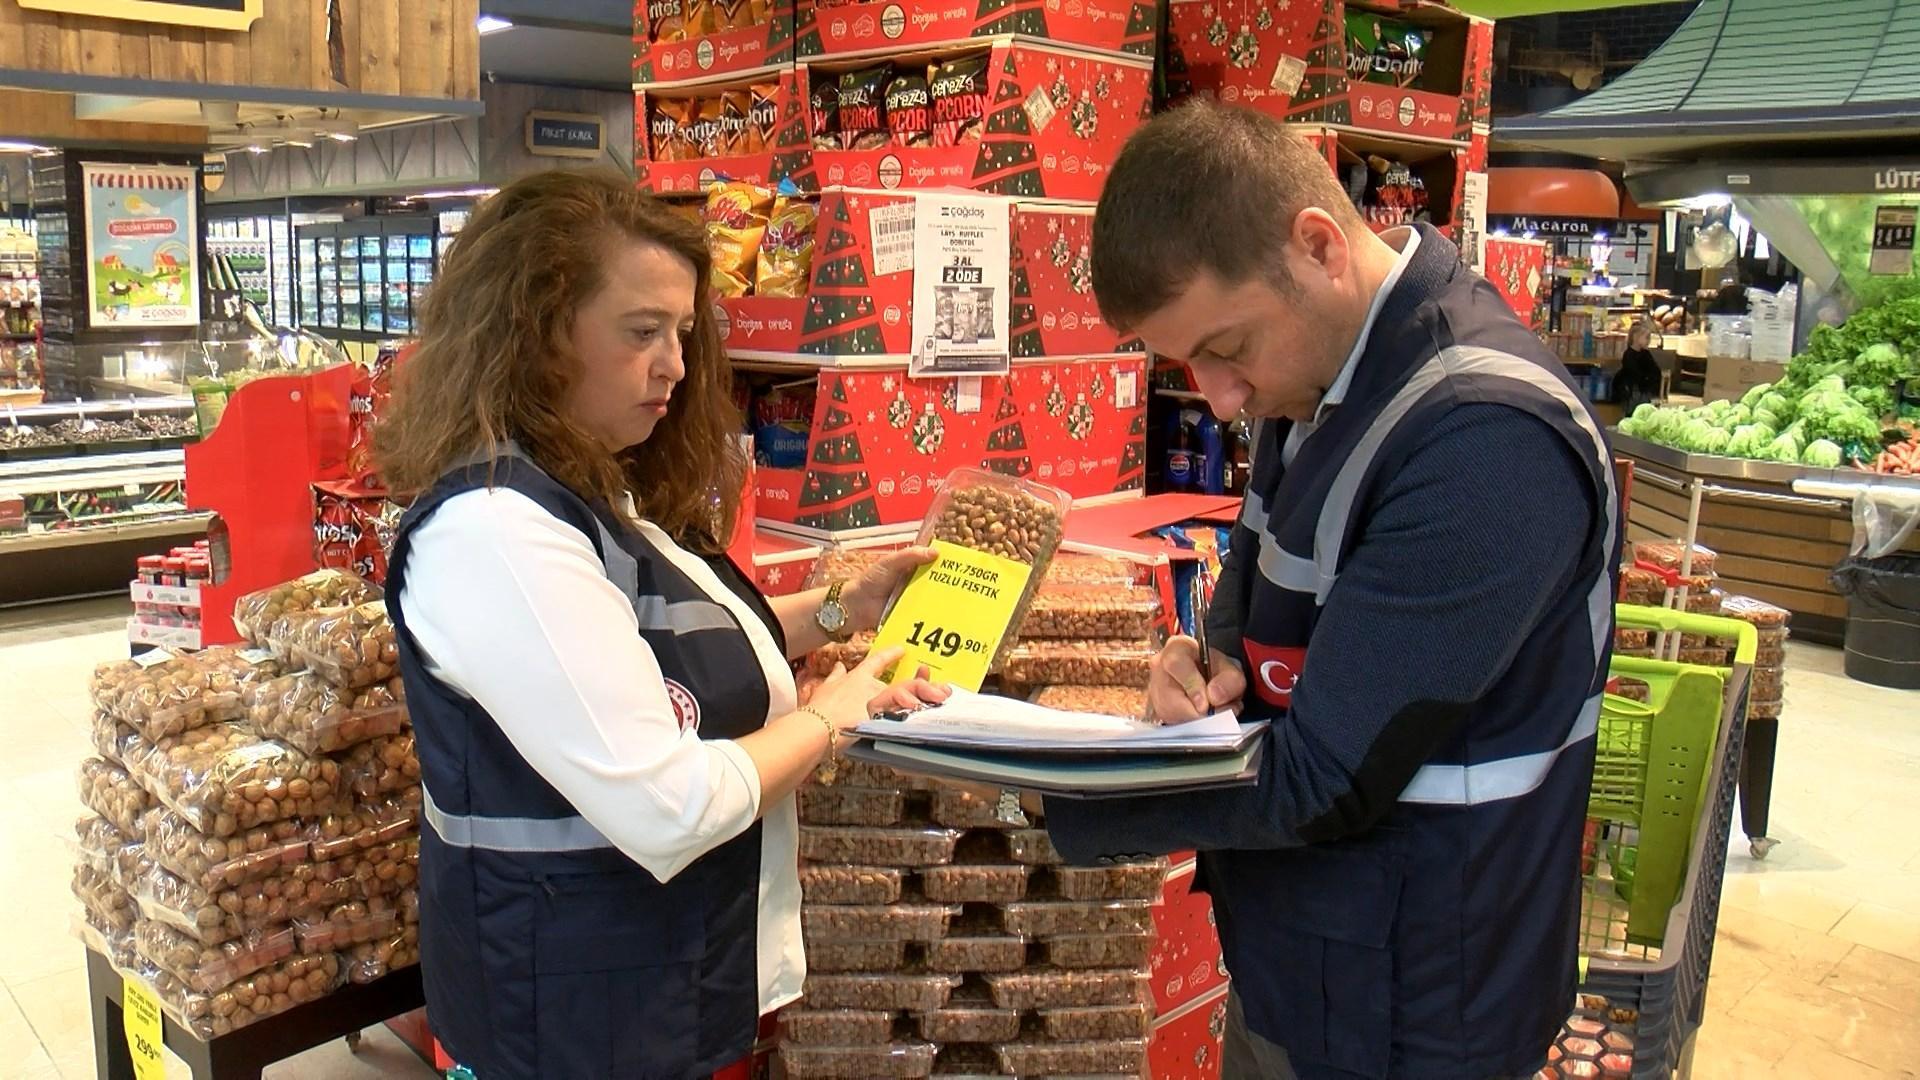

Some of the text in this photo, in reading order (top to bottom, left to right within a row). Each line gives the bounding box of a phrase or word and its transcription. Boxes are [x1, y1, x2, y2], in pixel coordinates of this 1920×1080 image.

[649, 0, 681, 19] ritos
[932, 75, 974, 99] cerezza
[886, 90, 927, 110] cerezza
[1512, 217, 1589, 233] Macaron
[953, 255, 973, 267] 3 AL
[946, 269, 955, 283] 2
[941, 559, 999, 584] KRY.750GR
[929, 570, 1000, 600] TUZLU FISTIK
